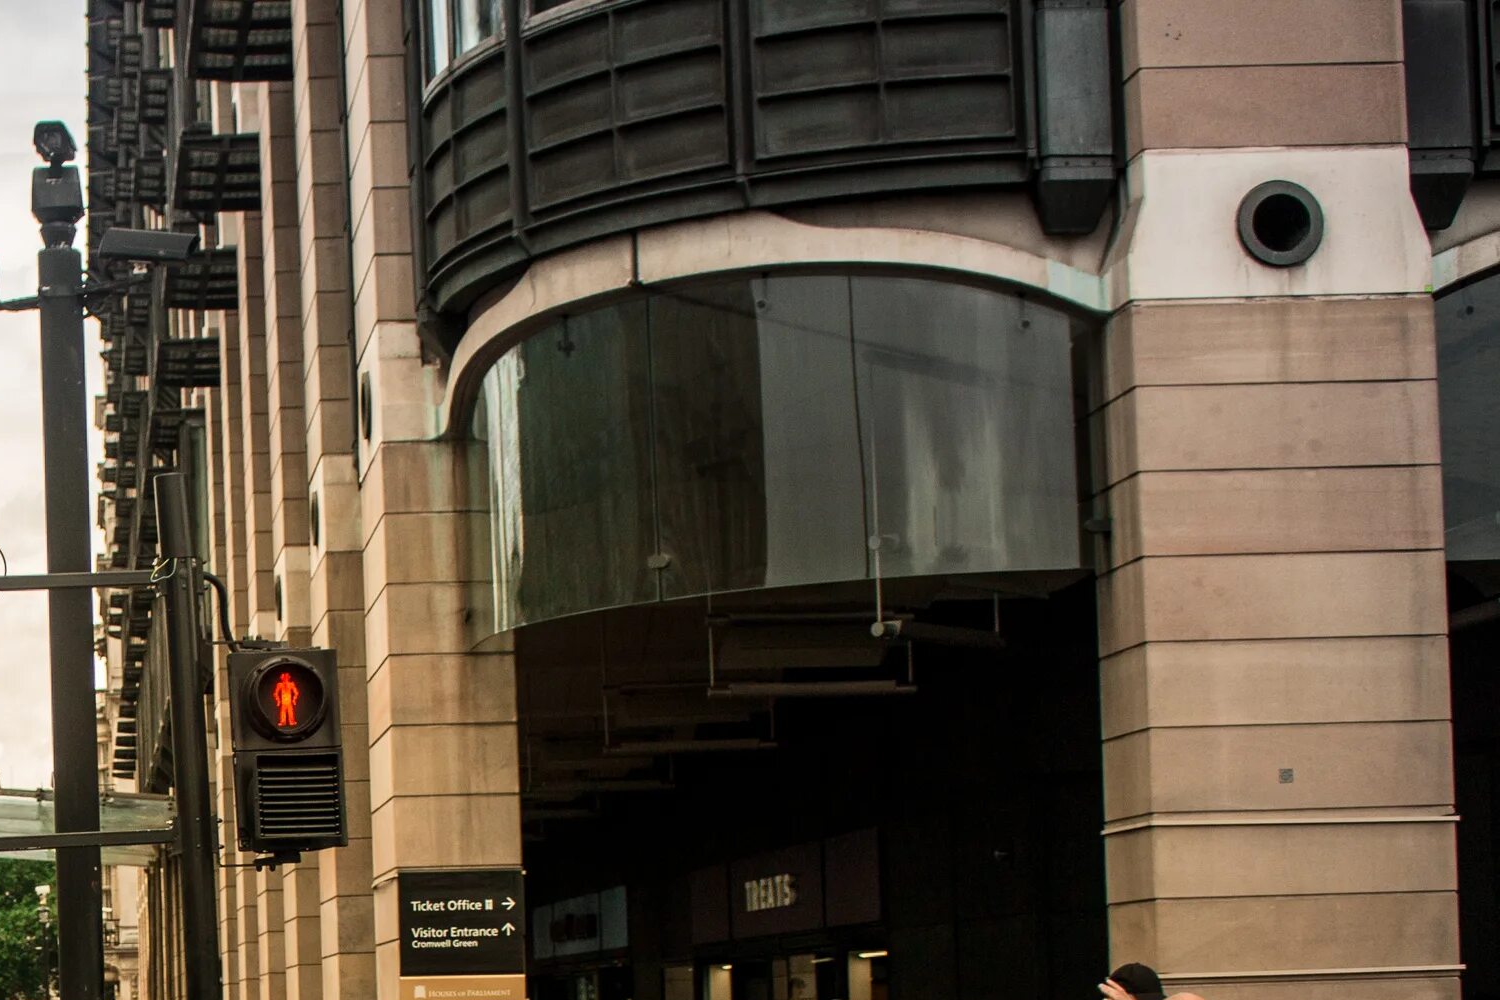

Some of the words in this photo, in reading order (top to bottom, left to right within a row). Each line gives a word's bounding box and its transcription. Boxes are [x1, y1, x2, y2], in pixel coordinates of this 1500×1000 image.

[745, 873, 793, 912] TREATS
[410, 900, 445, 911] Ticket
[447, 899, 482, 911] Office
[411, 928, 448, 938] Visitor
[450, 927, 499, 937] Entrance
[412, 940, 451, 948] Cromwell
